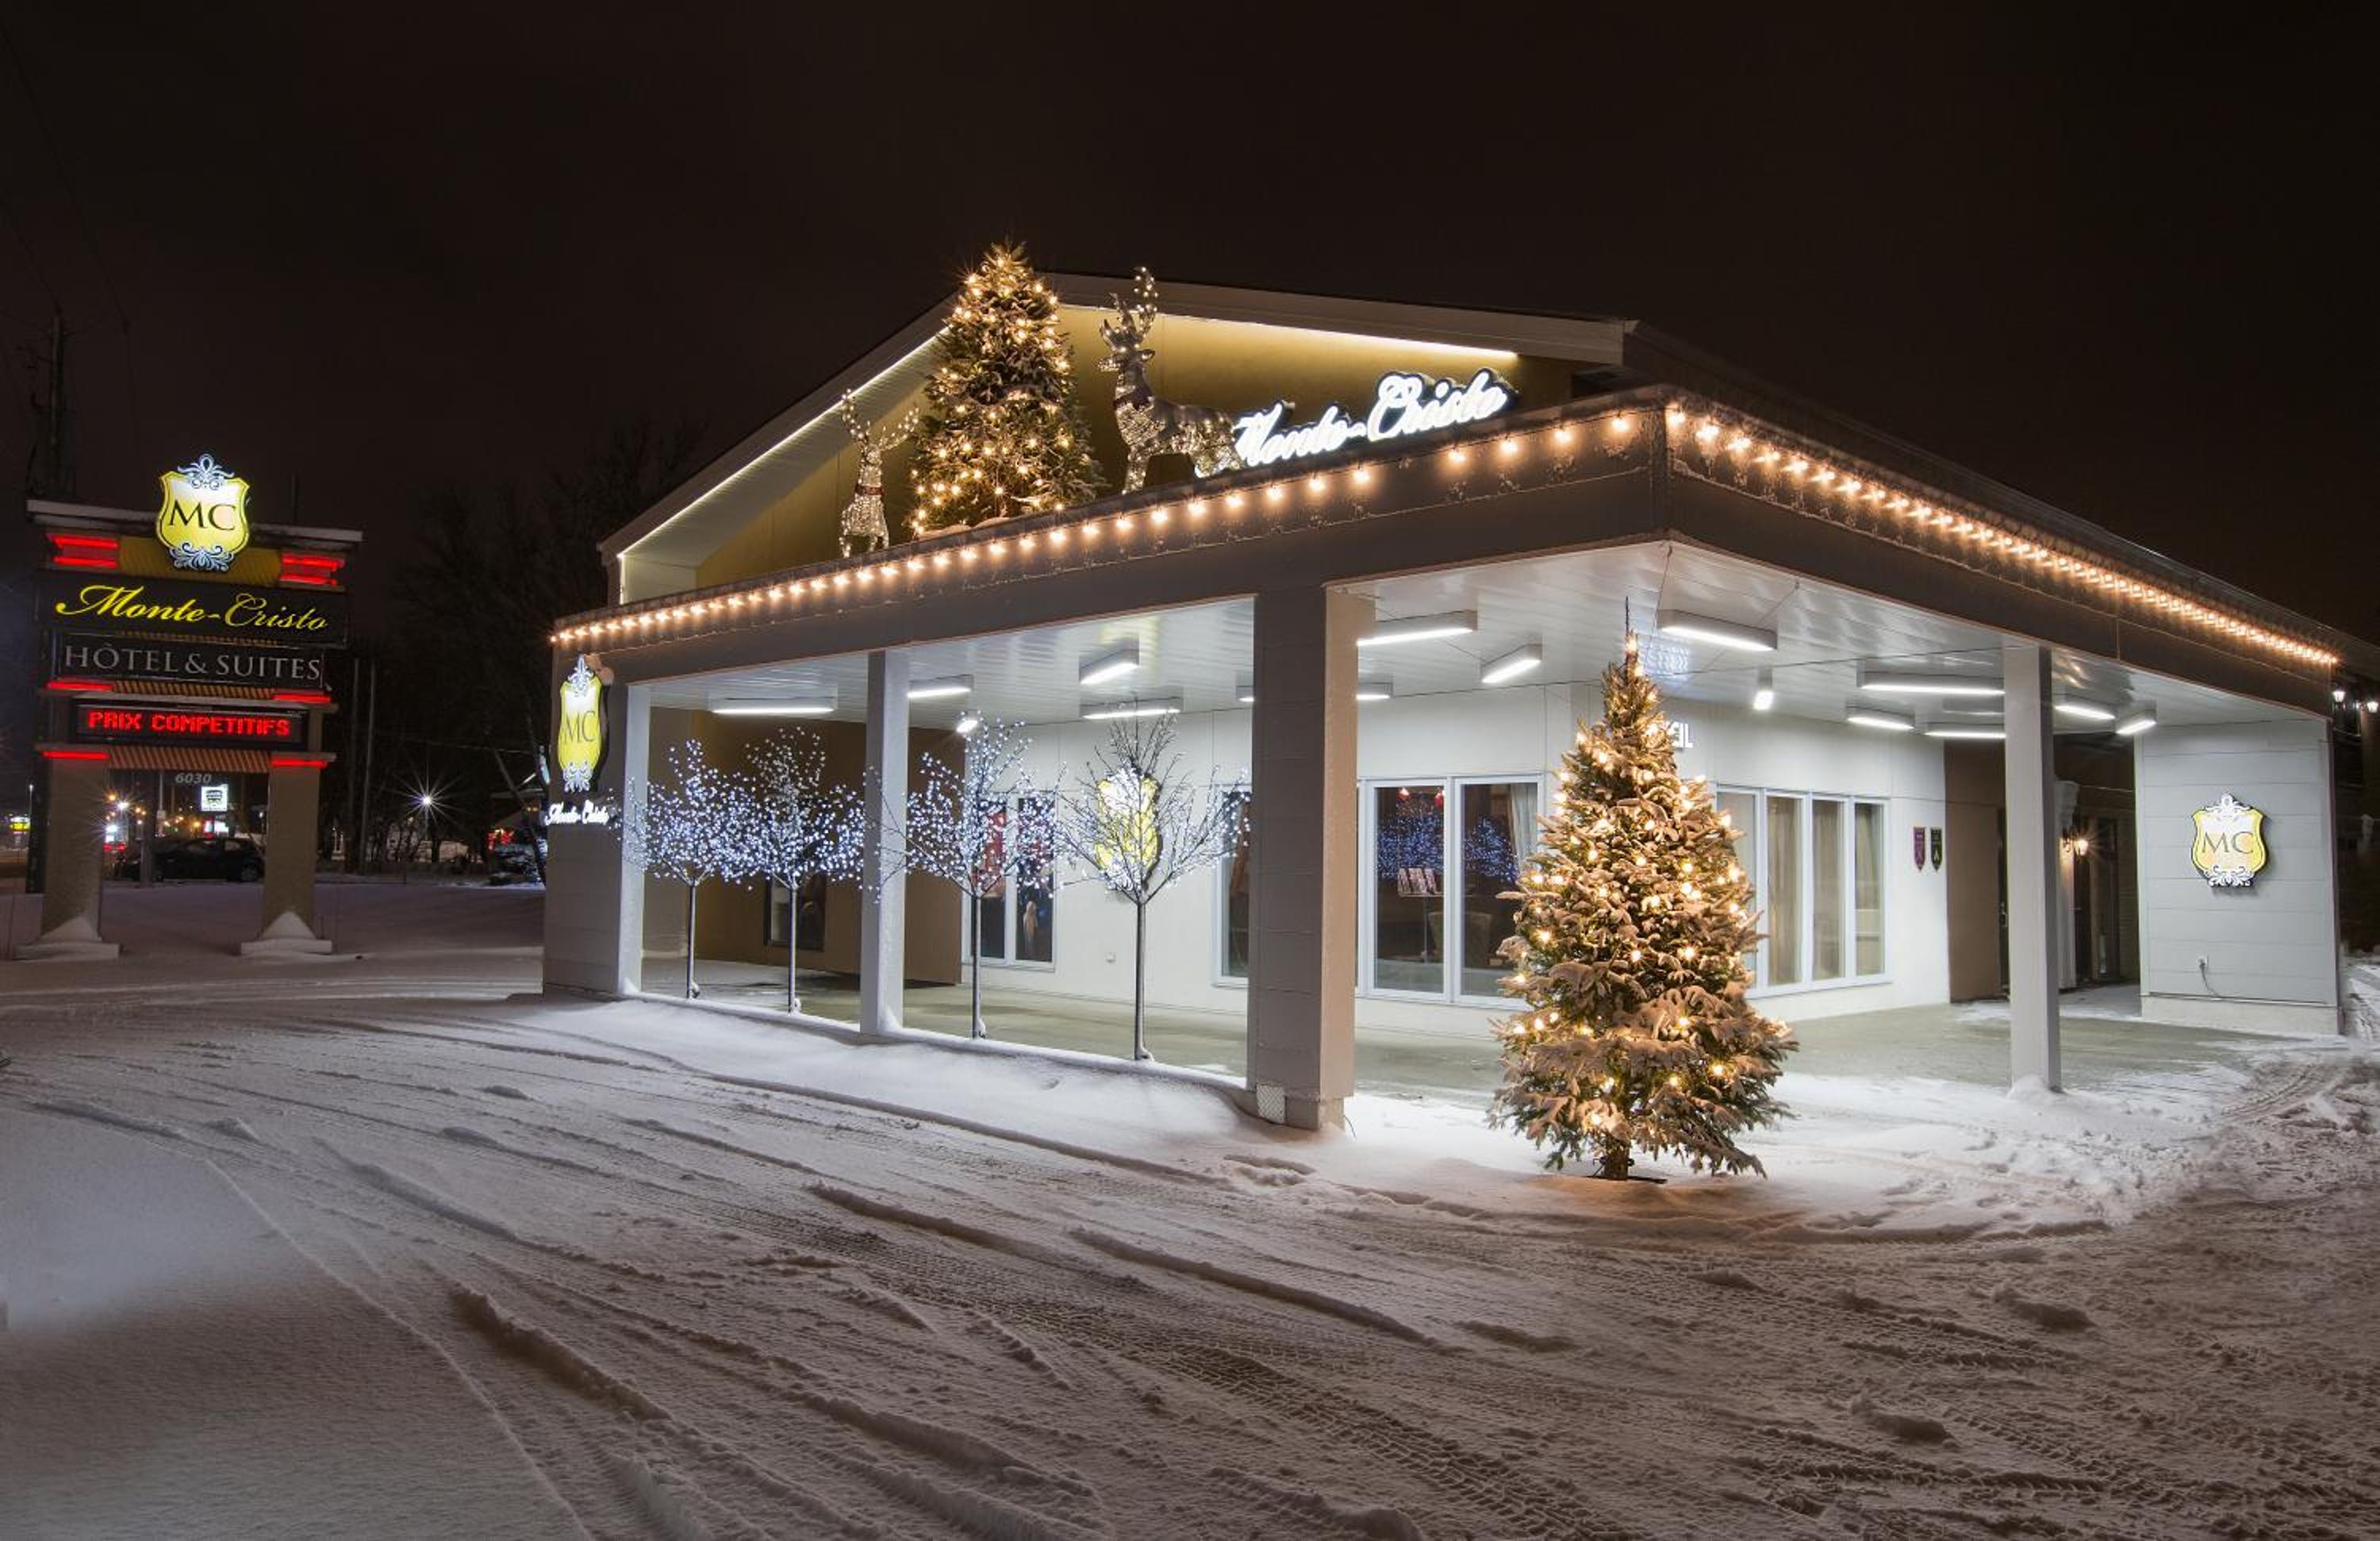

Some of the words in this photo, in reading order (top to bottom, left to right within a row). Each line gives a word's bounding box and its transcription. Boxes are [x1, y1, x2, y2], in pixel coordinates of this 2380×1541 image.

[169, 500, 236, 531] MC
[56, 585, 329, 631] Monte-Cristo
[65, 644, 178, 672] HÔTEL
[185, 653, 206, 674] &
[216, 654, 321, 680] SUITES
[89, 711, 142, 730] PRIX
[152, 714, 291, 736] COMPETITIFS
[564, 710, 596, 744] MC
[175, 773, 212, 784] 6030
[2202, 831, 2254, 854] MC
